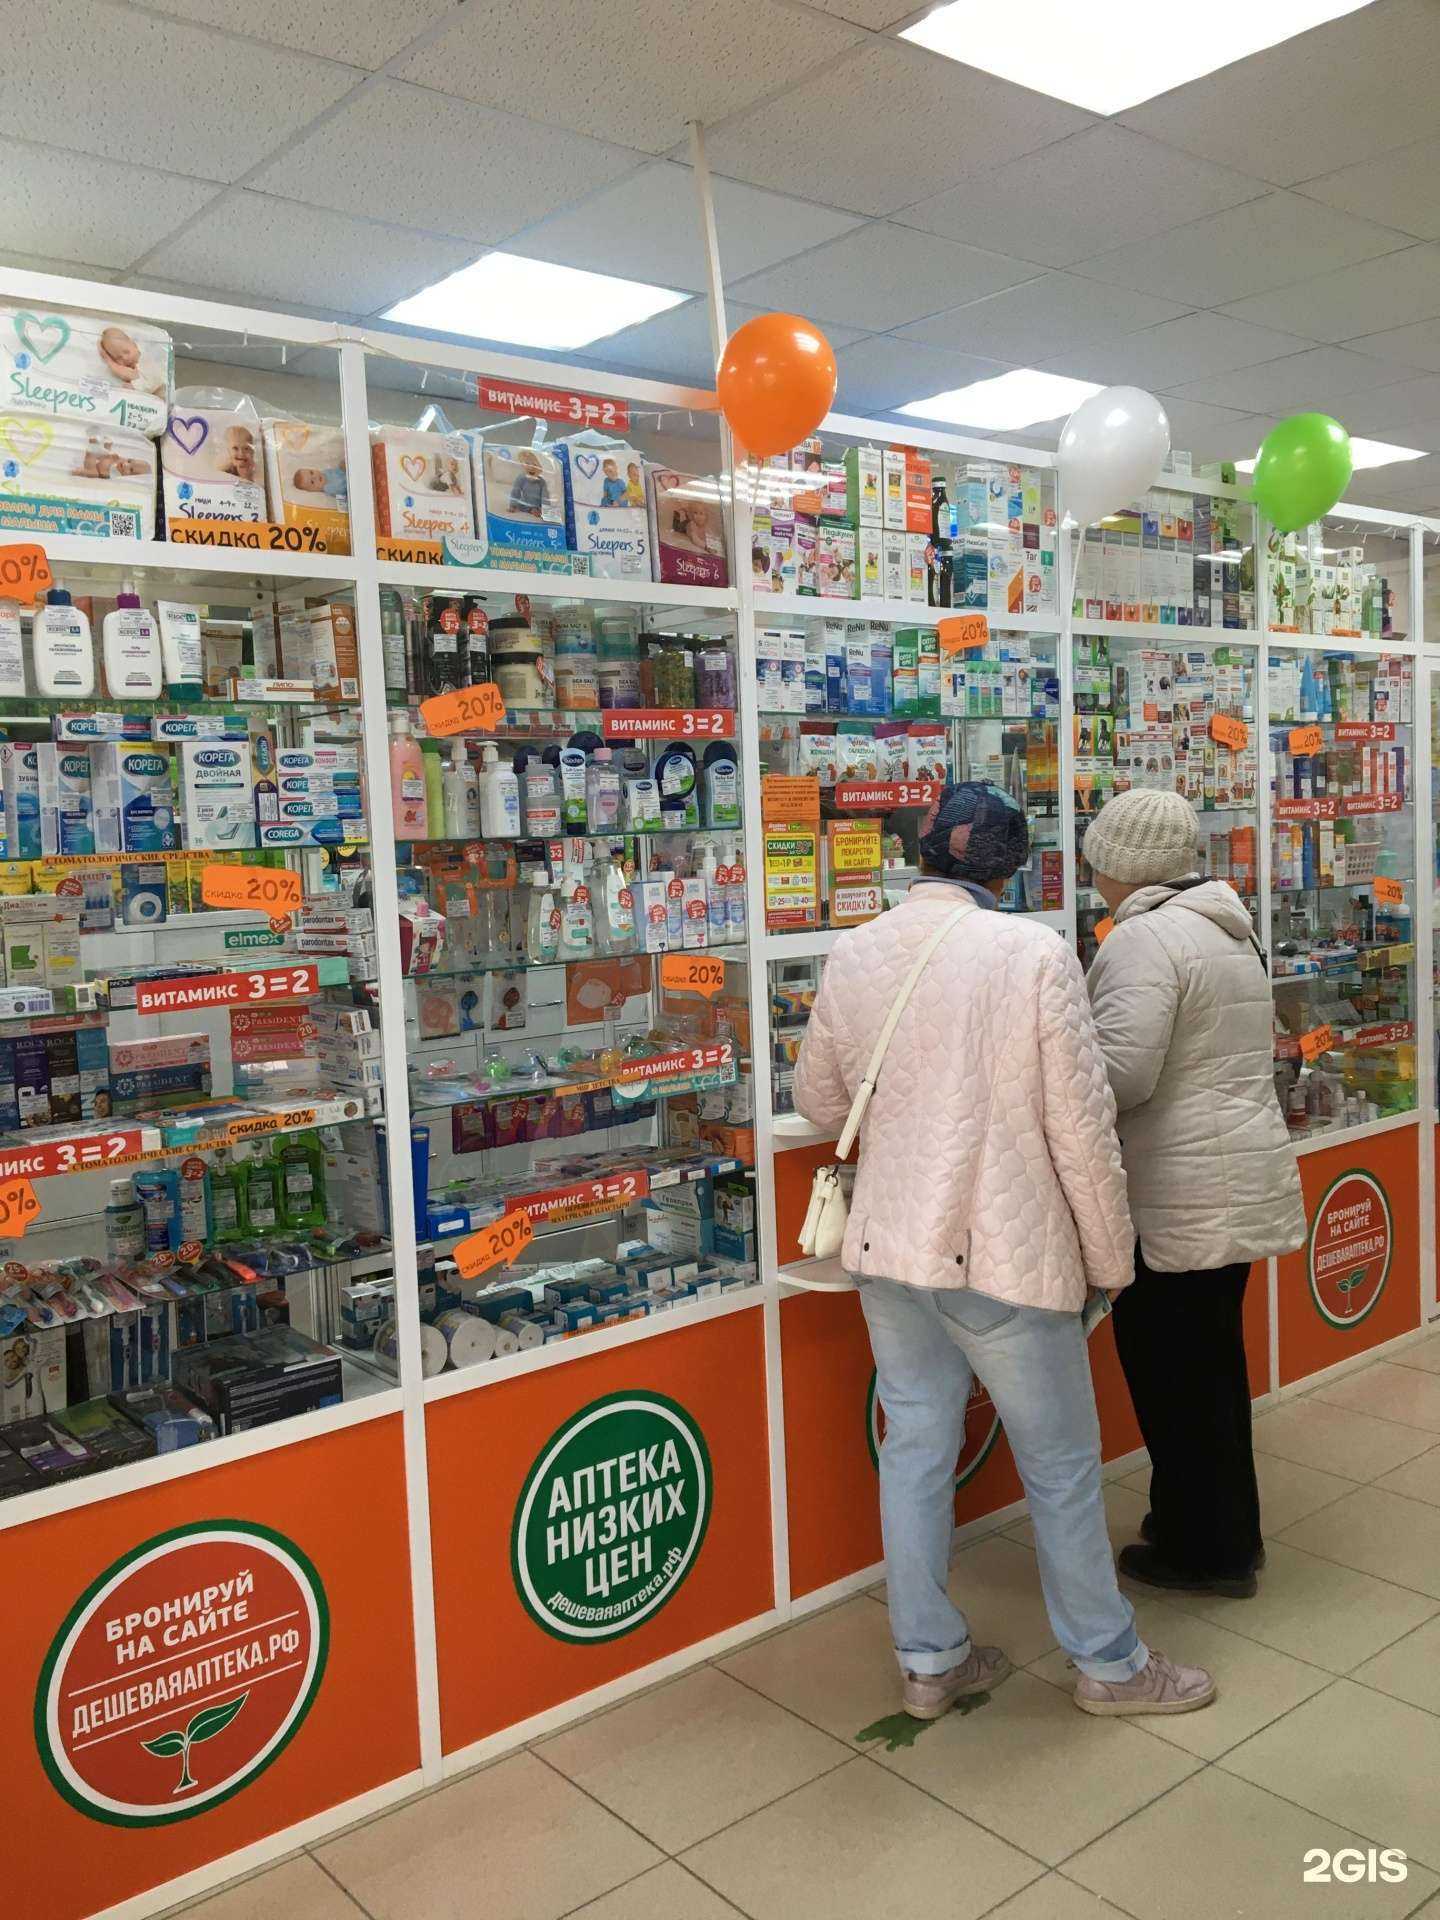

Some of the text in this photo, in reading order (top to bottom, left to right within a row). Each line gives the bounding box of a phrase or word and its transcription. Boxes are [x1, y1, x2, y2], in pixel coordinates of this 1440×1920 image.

[10, 371, 127, 426] Sleepers 1
[488, 389, 617, 425] ВИТАМИКС 3=2
[402, 509, 454, 538] Sleepers
[269, 526, 327, 552] 20%
[587, 534, 645, 559] Sleepers 5
[0, 555, 48, 585] 0%
[676, 559, 720, 581] Sleepers 6
[961, 621, 988, 641] 20%
[458, 692, 503, 721] 20%
[611, 713, 724, 734] ВИТАМИКС 3=2
[1370, 725, 1390, 738] 3=2
[128, 759, 164, 771] КОРЕГА
[198, 751, 235, 763] КОРЕГА
[284, 755, 310, 765] КОРЕГА
[196, 769, 241, 780] ДВОЙНАЯ
[843, 784, 932, 802] ВИТАМИКС 3=2
[1378, 796, 1398, 811] 3=2
[1313, 801, 1335, 816] 3=2
[267, 829, 301, 840] COREGA
[247, 878, 300, 902] 20%
[303, 915, 334, 925] parodontax
[228, 934, 280, 947] elmex
[301, 937, 335, 947] parodontax
[689, 965, 723, 985] 20%
[142, 970, 310, 1008] ВИТАМИКС 3=2
[1390, 1026, 1409, 1041] 3=2
[692, 1043, 733, 1069] 3=2
[284, 1111, 312, 1126] 20%
[56, 1137, 127, 1171] 3=2
[592, 1177, 635, 1201] 3=2
[1327, 1198, 1372, 1224] БРОНИРУЙ
[489, 1218, 531, 1255] 20%
[1330, 1215, 1370, 1237] НА САЙТЕ
[1317, 1235, 1384, 1273] ДЕШЕВАЯАПТЕКА.РФ
[548, 1439, 681, 1519] АПТЕКА
[546, 1479, 686, 1565] НИЗКИХ
[586, 1536, 651, 1598] ЦЕН
[547, 1545, 682, 1622] дешеваяаптека.рф
[105, 1569, 254, 1642] БРОНИРУЙ
[116, 1600, 248, 1665] НА САЙТЕ
[72, 1629, 300, 1738] ДЕШЕВАЯАПТЕКА.РФ
